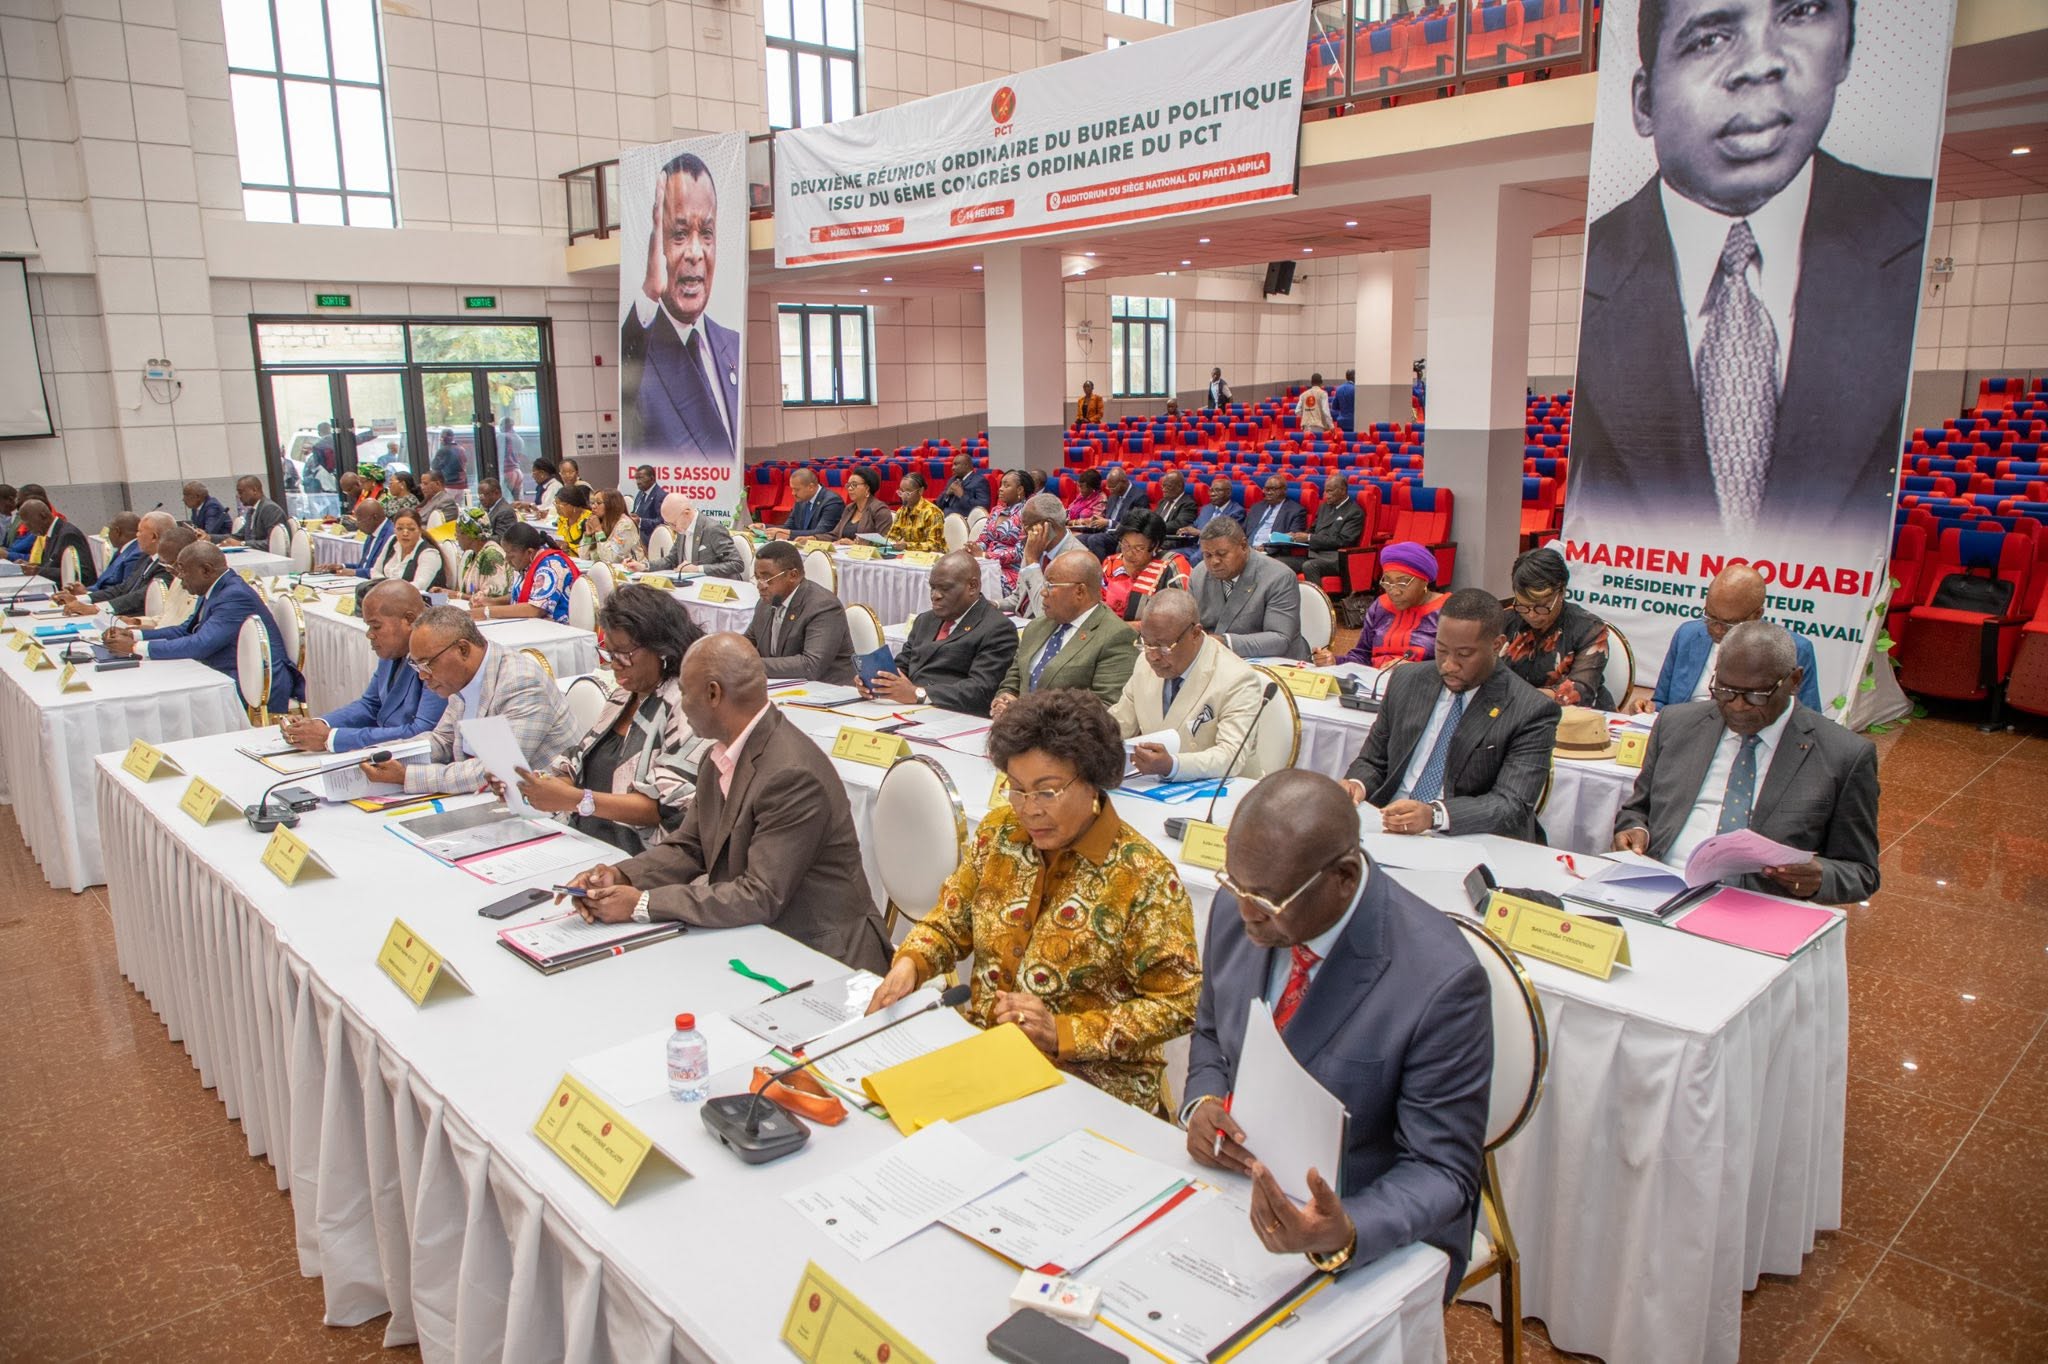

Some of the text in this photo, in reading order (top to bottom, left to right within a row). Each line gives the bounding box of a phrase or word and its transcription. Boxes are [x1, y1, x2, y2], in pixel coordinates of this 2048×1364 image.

[791, 78, 1292, 197] DEUXIÈME RÉUNION ORDINAIRE DU BUREAU POLITIQUE
[994, 124, 1013, 137] PCT
[829, 123, 1222, 211] ISSU DU 6ÈME CONGRÈS ORDINAIRE DU PCT
[1061, 159, 1265, 205] AUDITORIUM DU SIÈGE NATIONAL DU PARTI À MPILA
[974, 205, 1005, 218] HEURES
[857, 224, 873, 235] JUIN
[873, 223, 890, 233] 2026
[322, 296, 347, 306] SORTIE
[470, 298, 492, 307] SORTIE
[628, 466, 730, 481] DIS SASSOU
[1565, 540, 1690, 575] MARIEN
[1602, 574, 1696, 598] PRÉSIDENT
[1589, 592, 1637, 610] PARTI
[1641, 599, 1703, 619] CONGO
[1782, 618, 1864, 644] TRAVAIL
